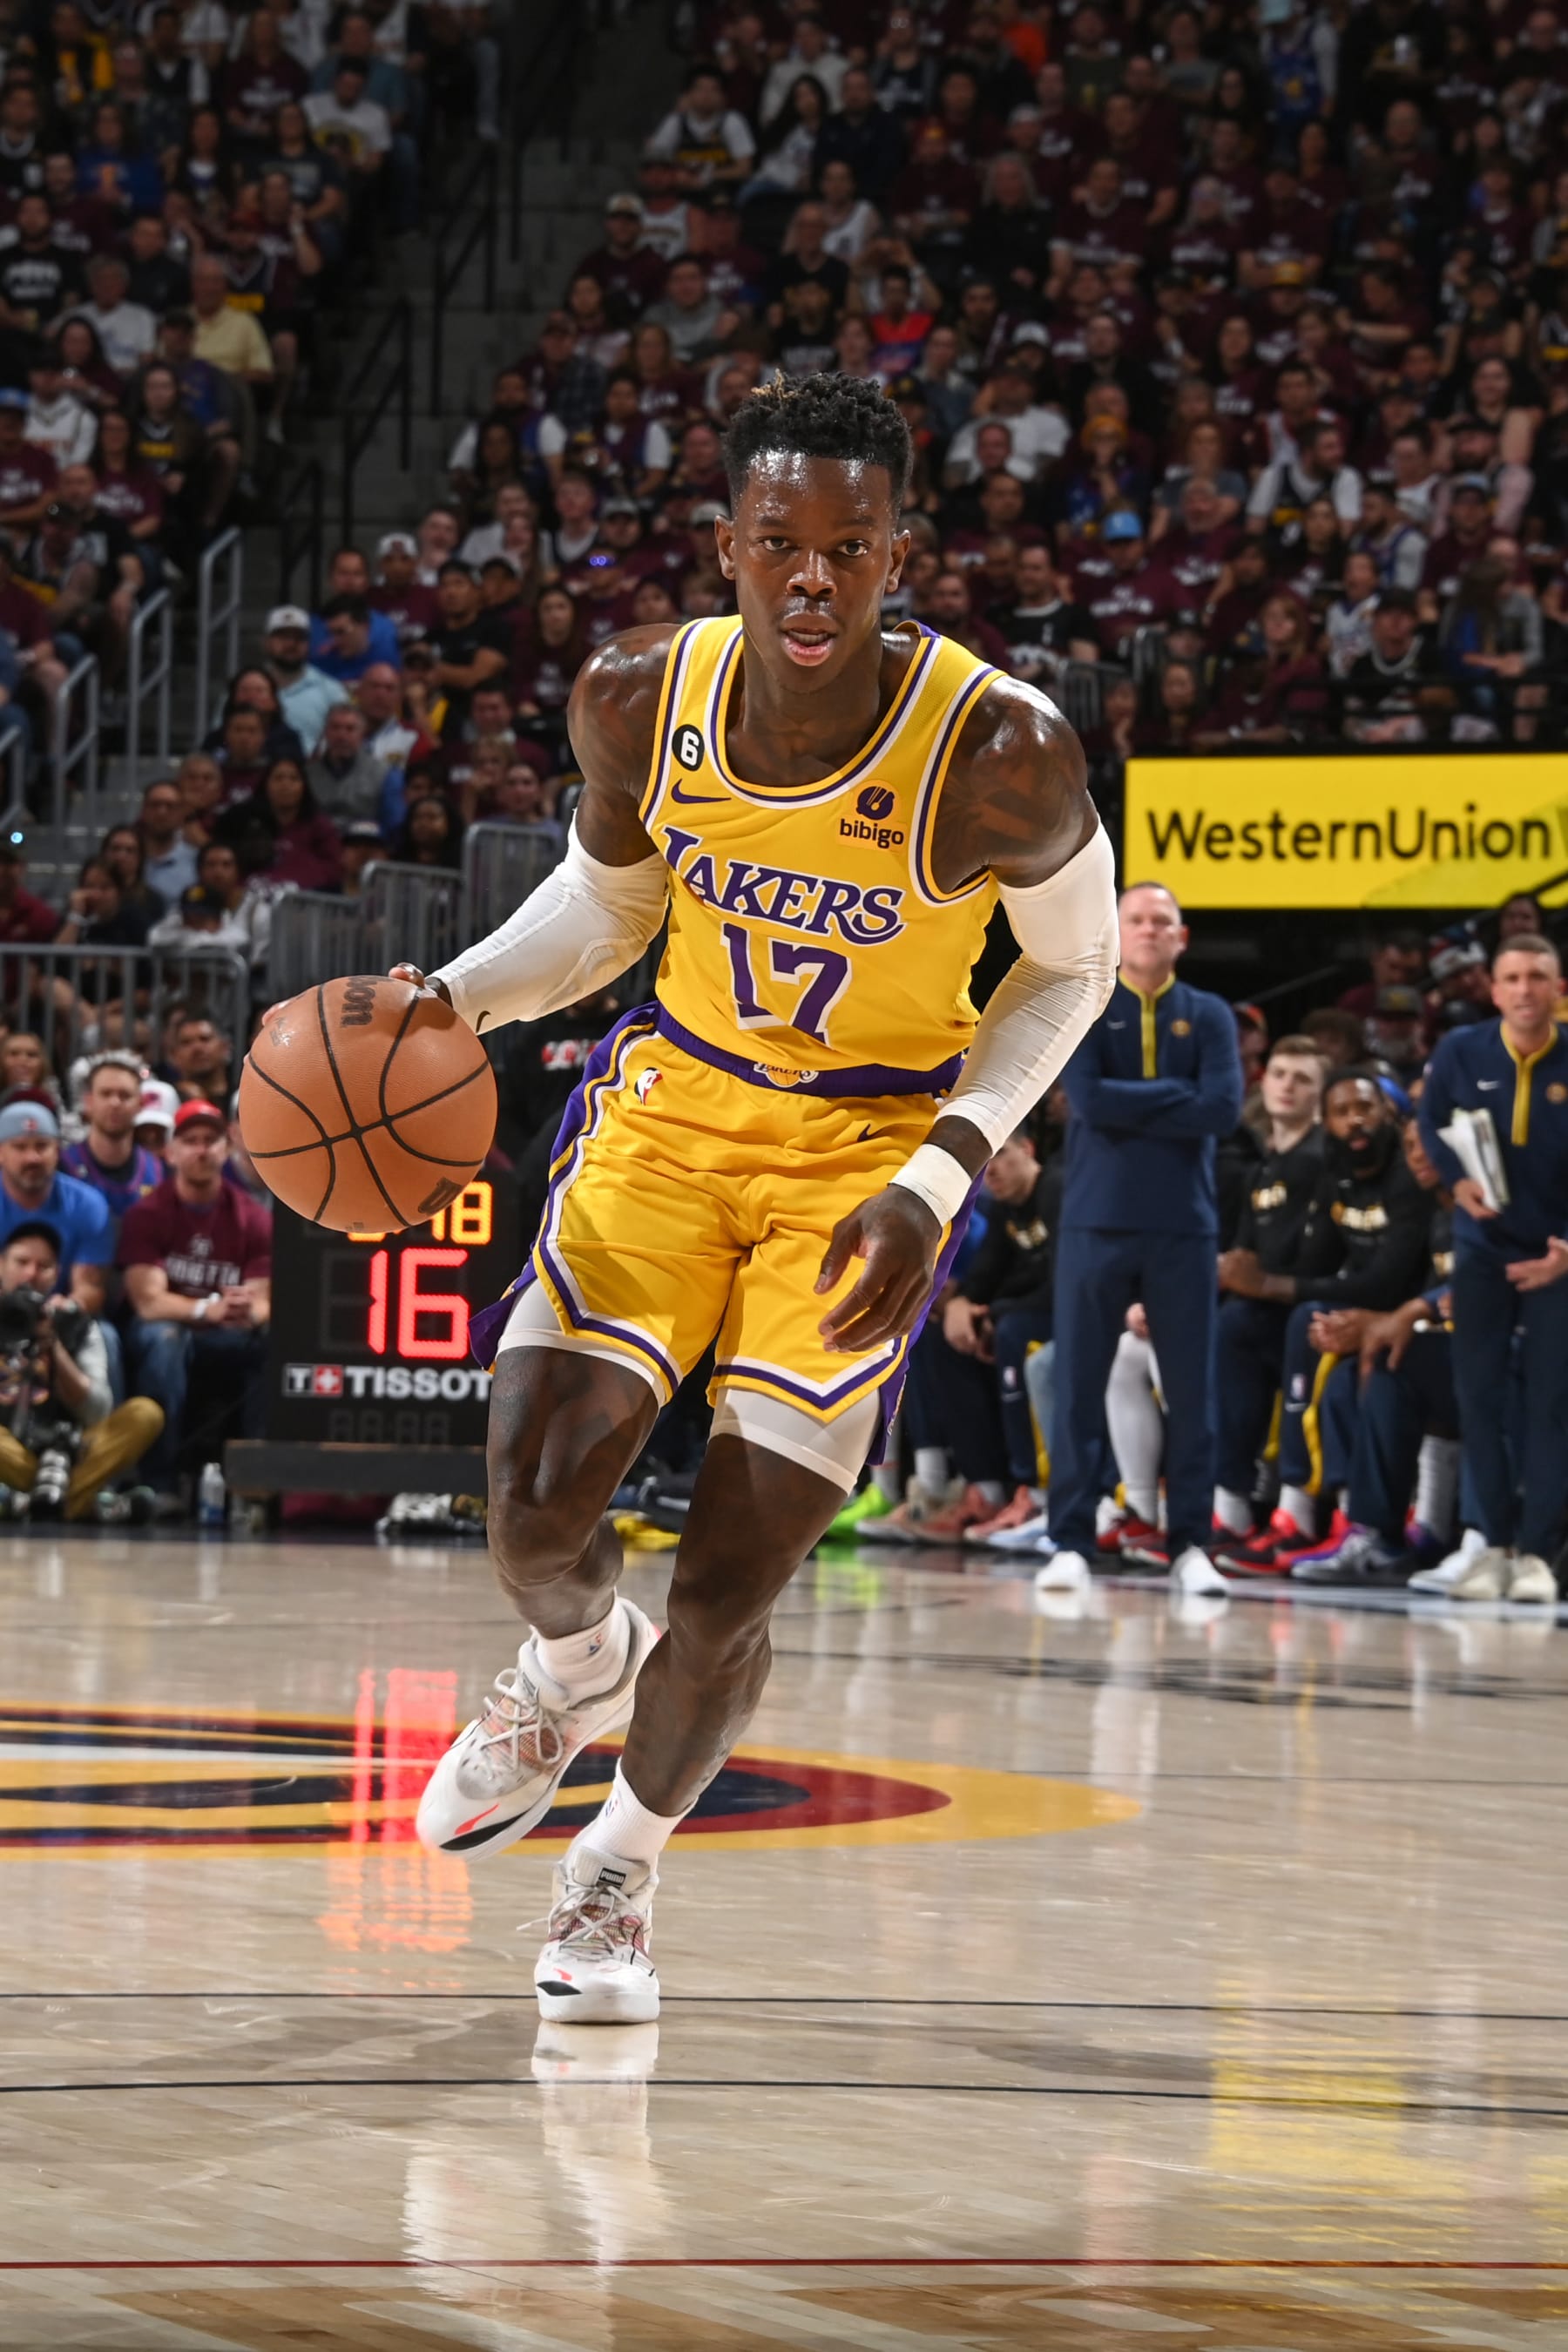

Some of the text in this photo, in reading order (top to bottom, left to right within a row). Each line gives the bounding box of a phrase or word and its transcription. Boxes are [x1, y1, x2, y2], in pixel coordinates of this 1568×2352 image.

[680, 732, 700, 766] 6
[839, 818, 903, 849] bibigo
[1146, 801, 1551, 862] WesternUnion
[663, 826, 905, 945] LAKERS
[720, 921, 852, 1049] 17
[368, 1247, 470, 1360] 16
[345, 1366, 493, 1402] TISSOT
